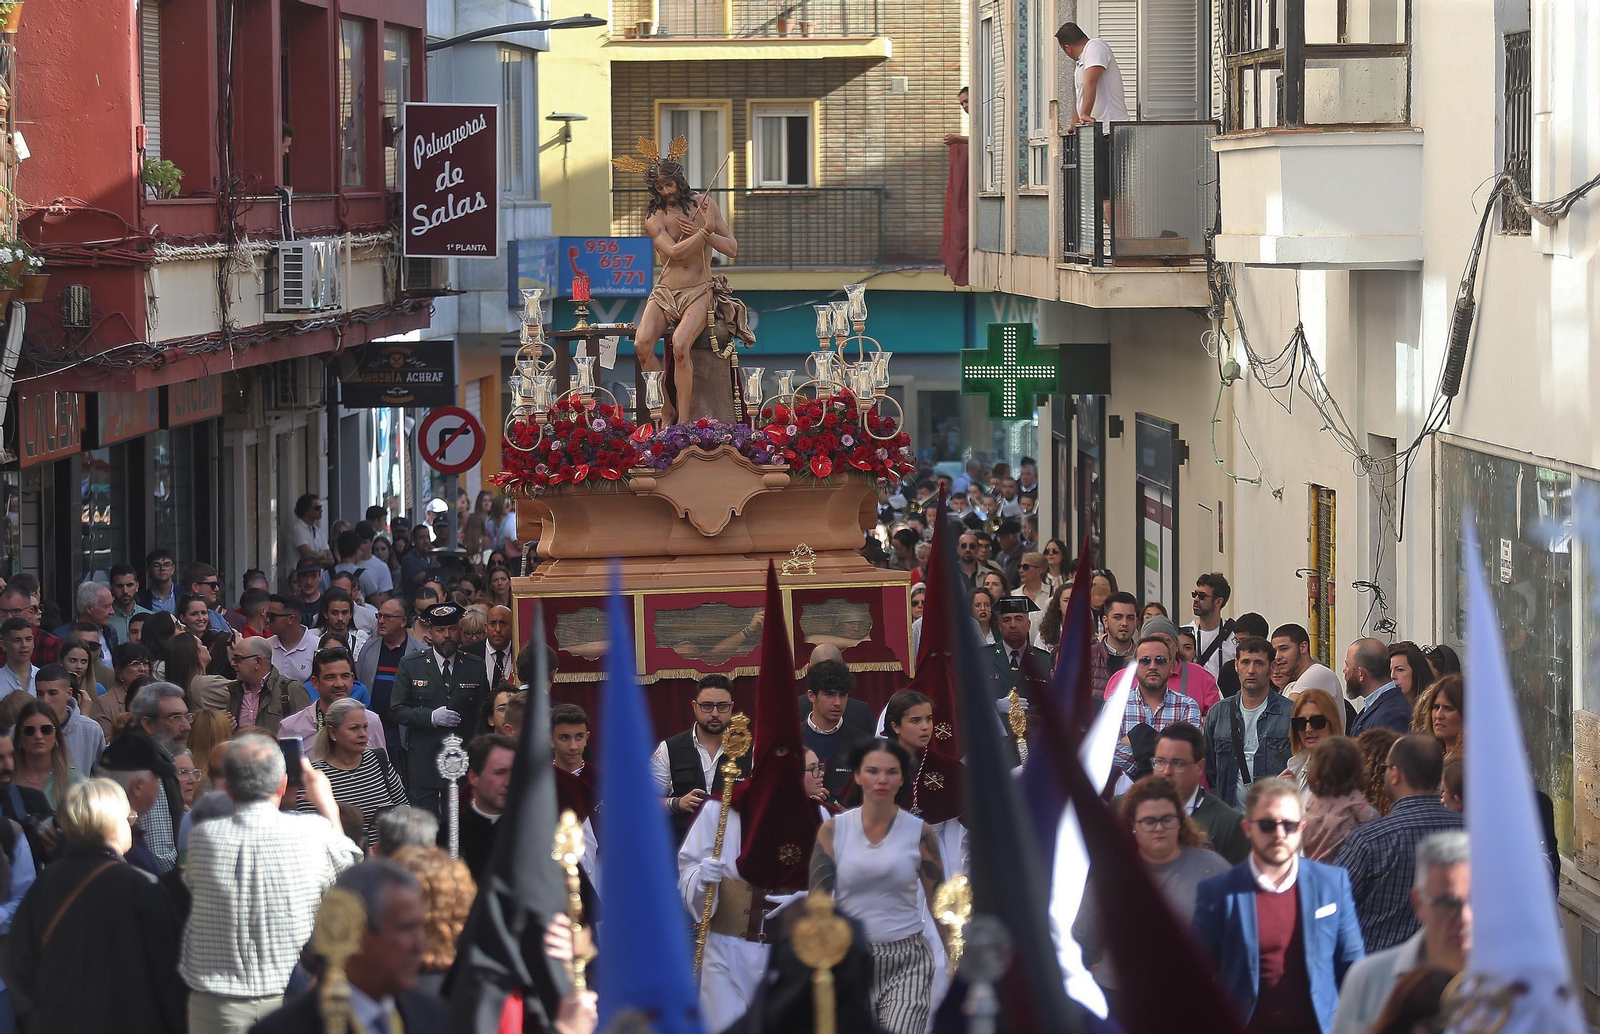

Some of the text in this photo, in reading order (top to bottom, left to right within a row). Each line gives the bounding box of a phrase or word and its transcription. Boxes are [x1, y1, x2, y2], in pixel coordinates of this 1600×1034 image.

[413, 113, 487, 170] Peluqueros
[434, 160, 465, 193] de
[411, 191, 488, 236] Salas
[585, 239, 620, 254] 956
[599, 255, 636, 269] 657
[612, 271, 645, 285] 771
[359, 371, 444, 383] ARBERÍA ACHRAF
